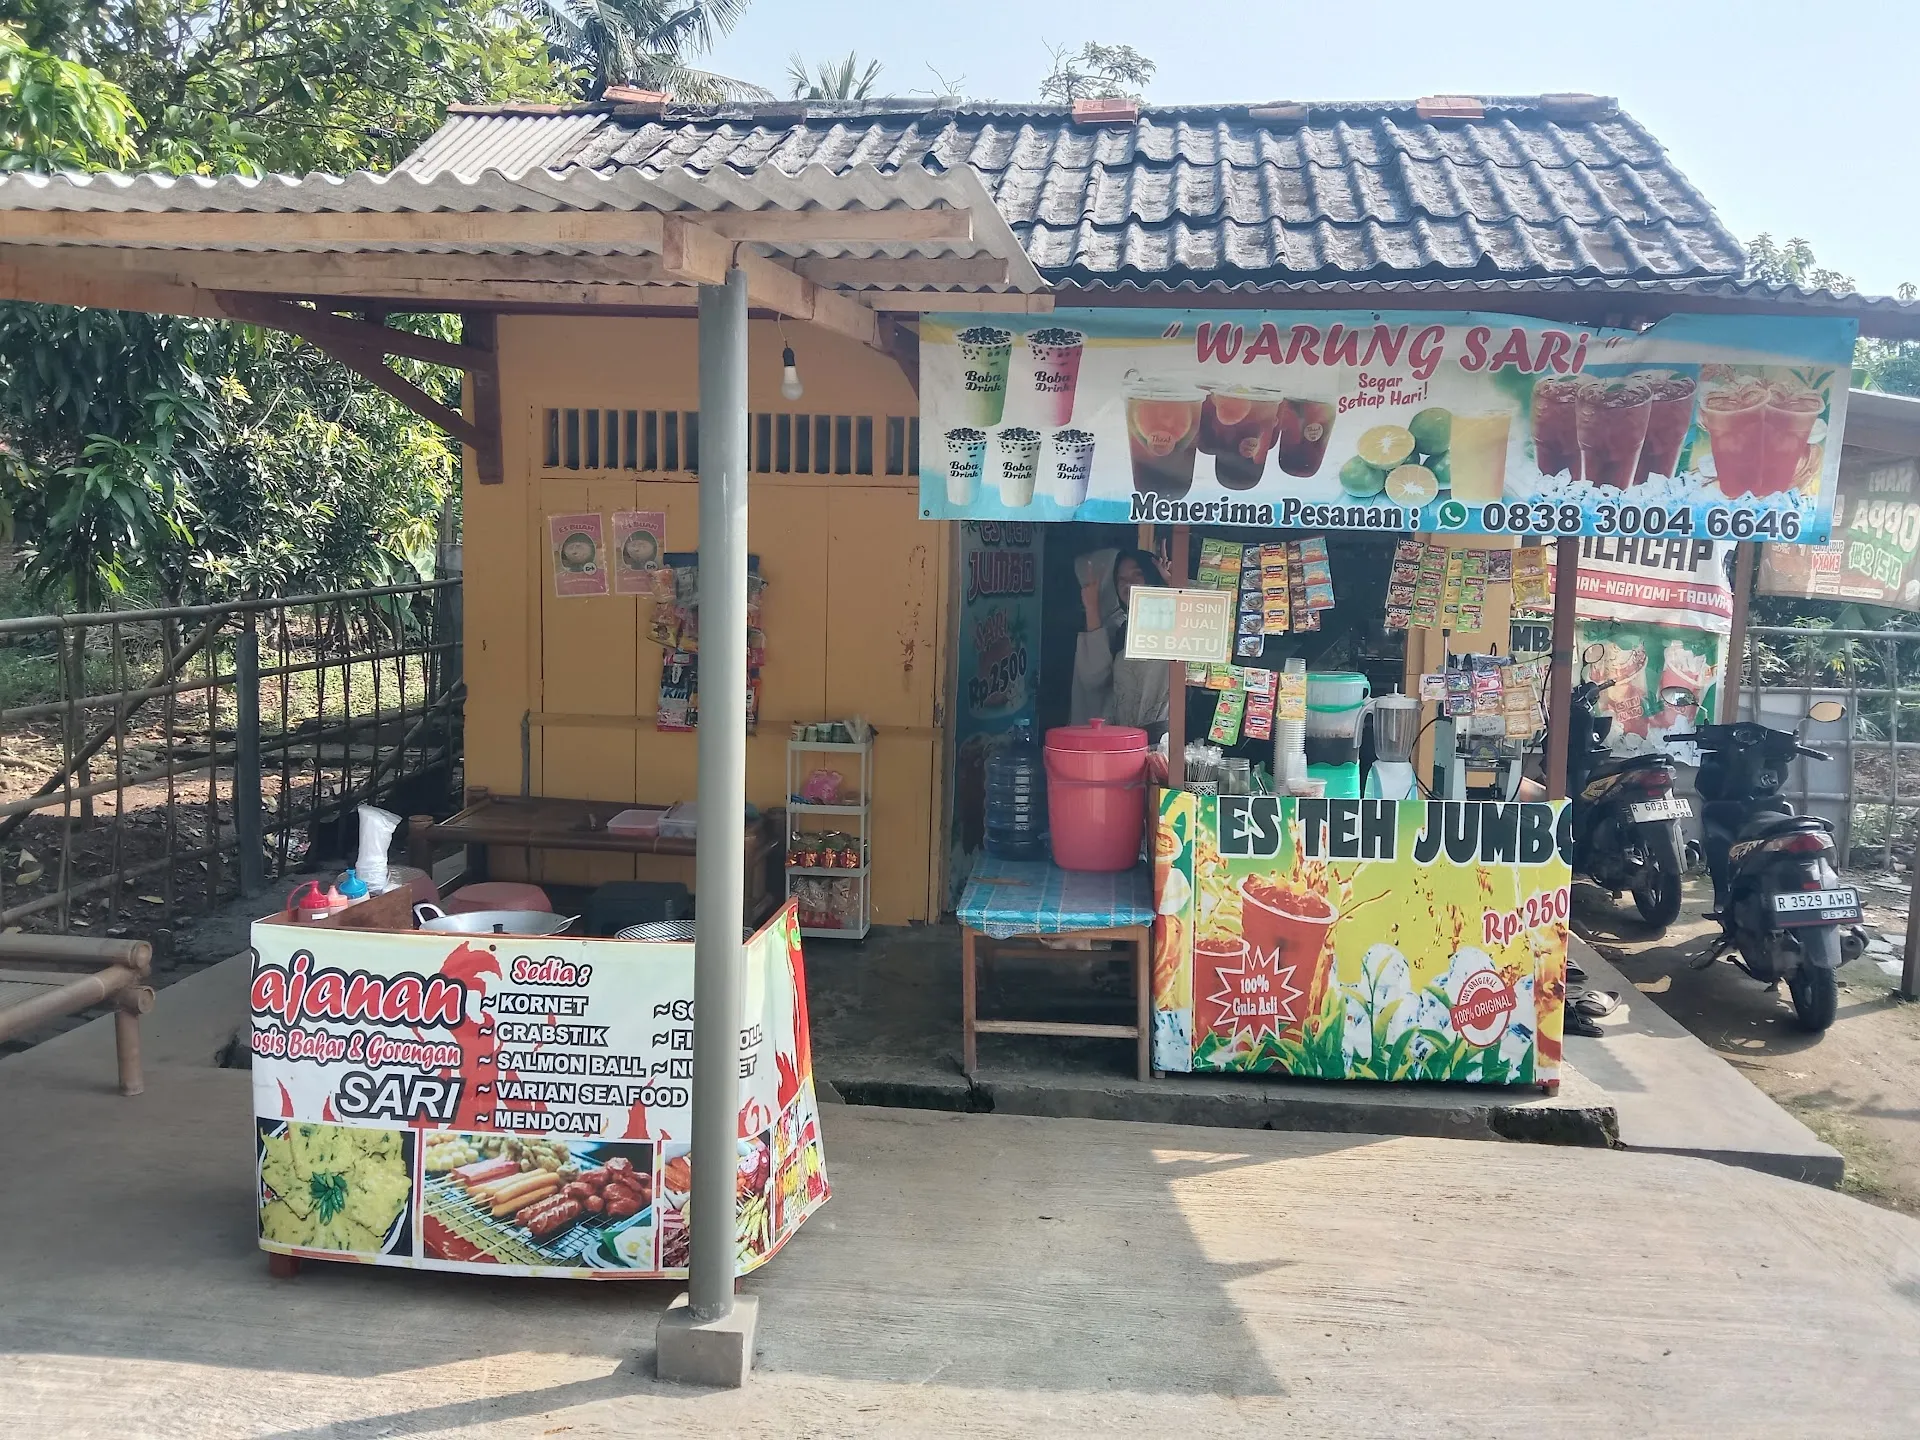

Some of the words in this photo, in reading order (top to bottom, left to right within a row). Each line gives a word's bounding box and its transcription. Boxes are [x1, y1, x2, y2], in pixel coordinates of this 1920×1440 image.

[1197, 323, 1445, 380] WARUNG
[964, 370, 1001, 382] Boba
[1034, 371, 1072, 383] Boba
[1358, 373, 1403, 391] Segar
[964, 382, 1001, 392] Drink
[1035, 383, 1071, 392] Drink
[1338, 393, 1385, 413] Setiap
[1391, 381, 1428, 405] Hari!
[949, 461, 979, 470] Boba
[1002, 461, 1032, 471] Boba
[1056, 463, 1086, 472] Boba
[950, 470, 979, 478] Drink
[1003, 471, 1032, 479] Drink
[1057, 472, 1086, 480] Drink
[1130, 493, 1273, 525] Menerima
[1483, 503, 1581, 532] 0838
[1595, 505, 1693, 534] 3004
[1707, 507, 1800, 538] 6646
[1180, 602, 1193, 612] DI
[1195, 603, 1221, 614] SINI
[1181, 618, 1218, 630] JUAL
[1134, 634, 1159, 649] ES
[1164, 635, 1219, 653] BATU
[1631, 804, 1639, 812] R
[1675, 801, 1688, 810] HT
[1218, 798, 1281, 856] ES
[1300, 799, 1397, 860] TEH
[1778, 896, 1787, 909] R
[1792, 895, 1823, 907] 3529
[1828, 893, 1854, 905] AWB
[251, 953, 461, 1026] ajanan
[1240, 974, 1270, 994] 100%
[1470, 976, 1497, 990] ORIGINAL
[1232, 998, 1257, 1016] Gula
[1258, 996, 1278, 1016] Asli
[1454, 1007, 1475, 1025] 100%
[1474, 994, 1513, 1017] ORIGINAL
[251, 1028, 286, 1056] osis
[288, 1029, 345, 1063] Bakar
[349, 1033, 365, 1059] &
[367, 1036, 461, 1069] Gorengan
[590, 1055, 647, 1077] BALL
[340, 1076, 461, 1119] SARI
